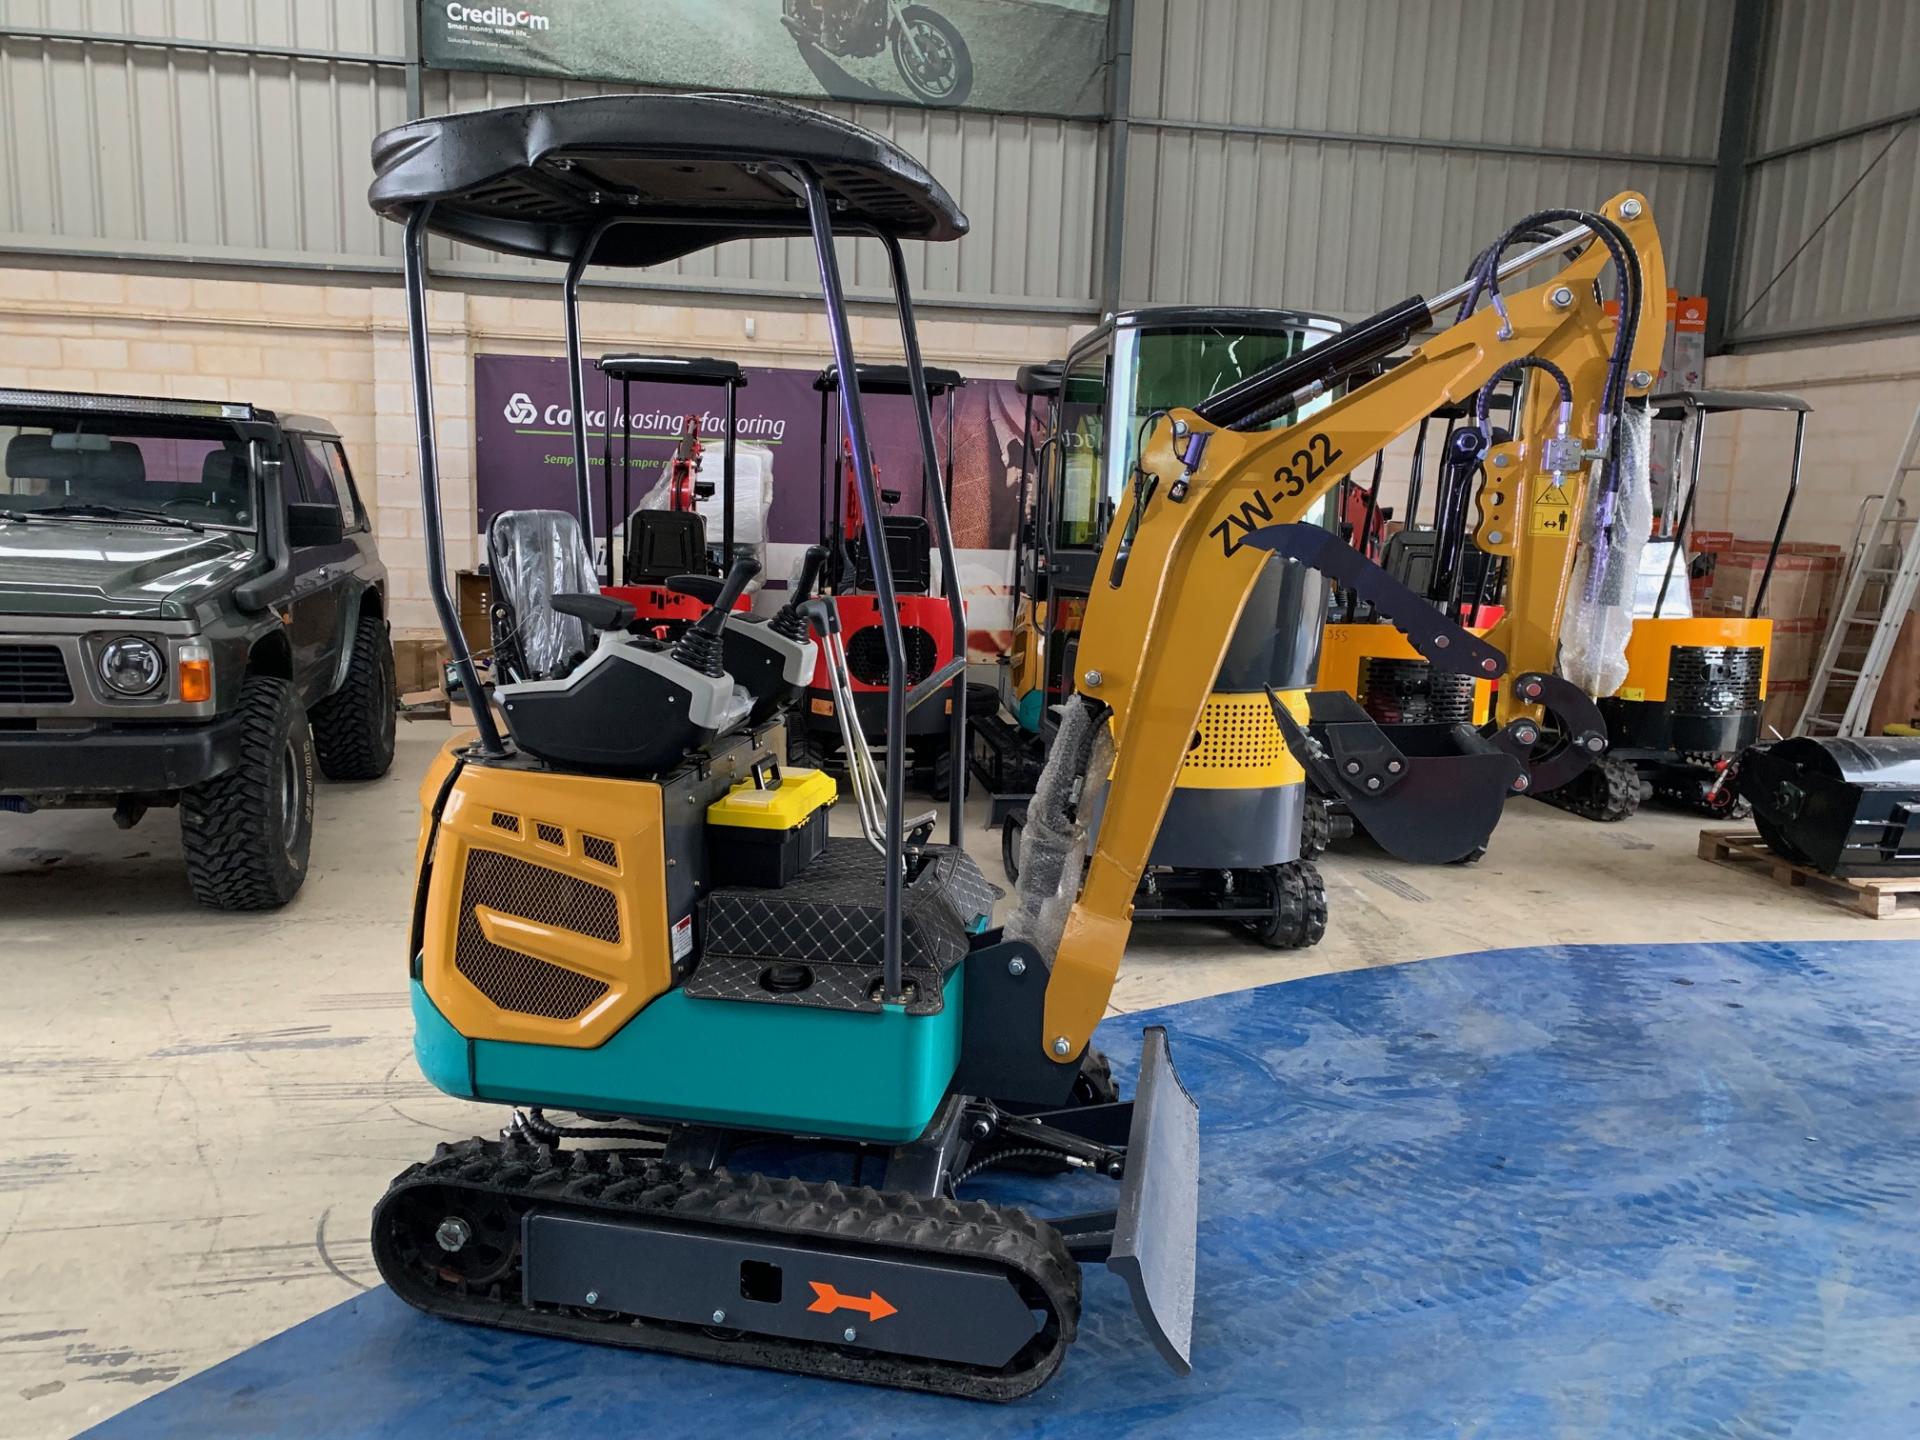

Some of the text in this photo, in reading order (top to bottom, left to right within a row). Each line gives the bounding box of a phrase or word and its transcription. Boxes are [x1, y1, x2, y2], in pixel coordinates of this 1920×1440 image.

[446, 2, 549, 31] Credibom
[447, 22, 468, 31] Smart
[544, 404, 606, 427] Caxa
[699, 410, 786, 440] facoring
[543, 454, 575, 467] Semp
[619, 457, 660, 470] Smpre
[1208, 432, 1343, 558] ZW-322
